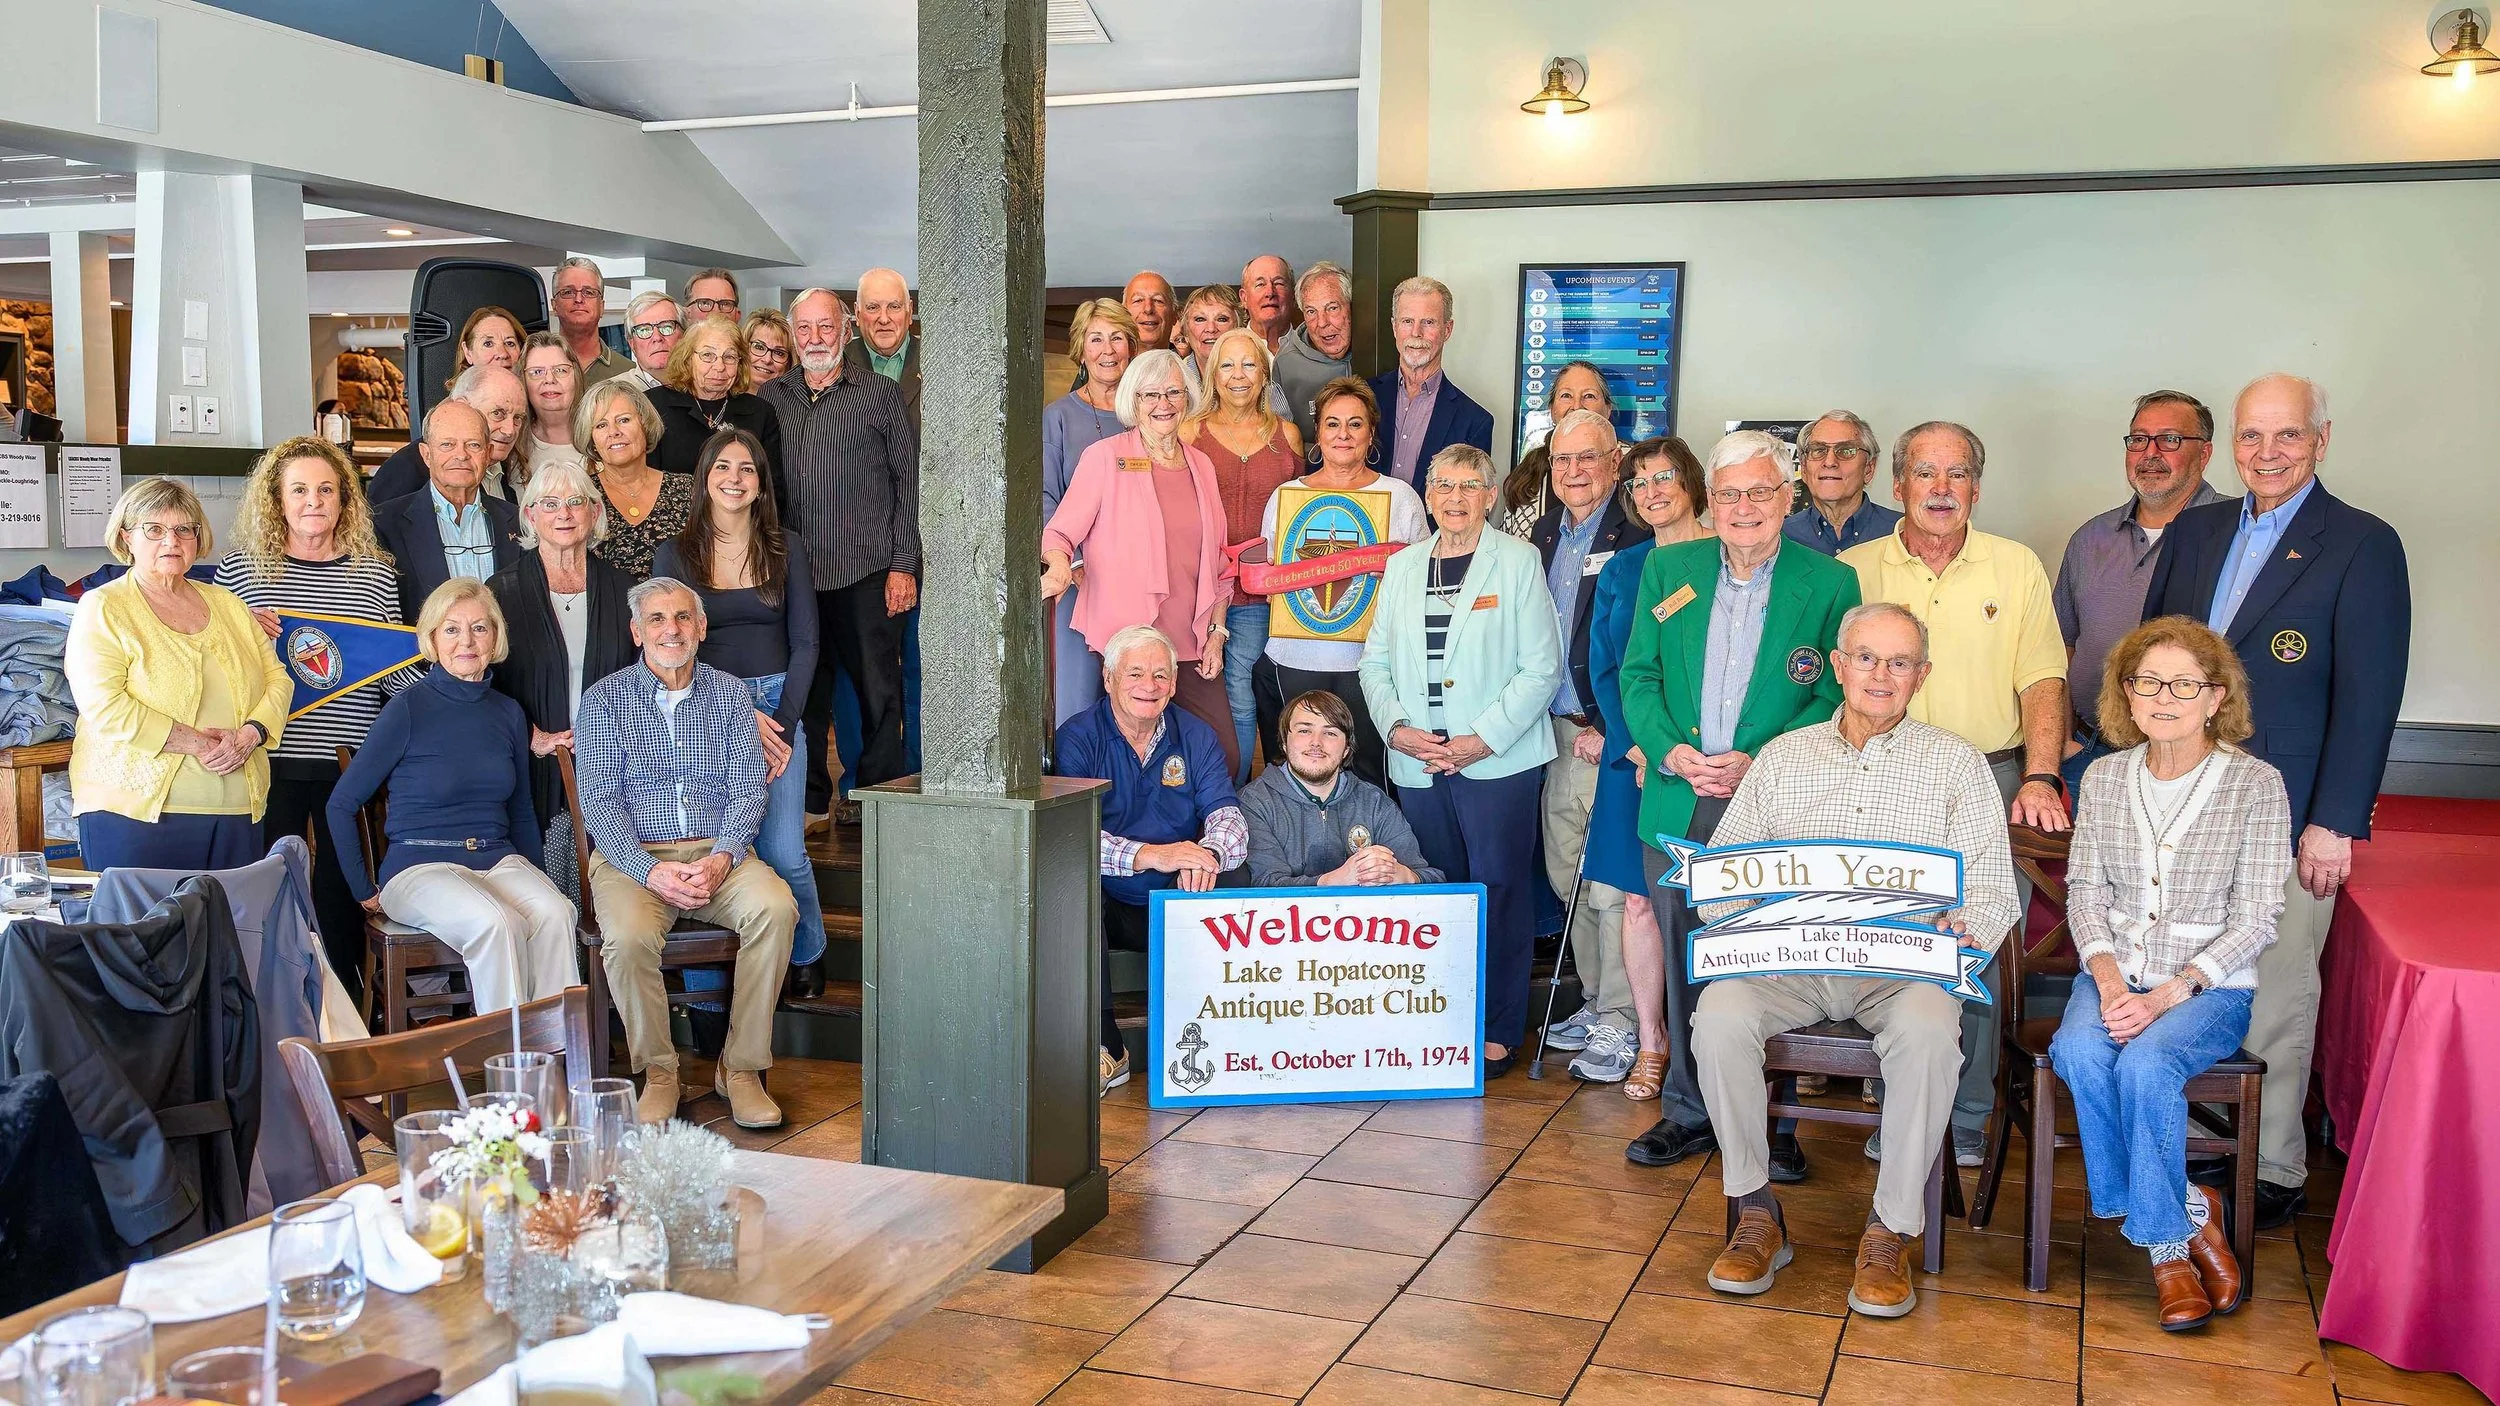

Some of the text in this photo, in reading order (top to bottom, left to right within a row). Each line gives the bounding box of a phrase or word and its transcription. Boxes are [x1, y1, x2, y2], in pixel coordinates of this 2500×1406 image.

[1565, 276, 1636, 285] UPCOMING EVENTS
[0, 513, 41, 522] 3-219-9016
[1264, 562, 1336, 588] Celebrating
[1338, 559, 1352, 572] 50
[1720, 853, 1926, 892] 50 th Year
[1200, 904, 1441, 952] Welcome
[1801, 927, 1935, 952] Lake Hopatcong
[1701, 946, 1869, 970] Antique Boat Club
[1222, 959, 1426, 987] Lake Hopatcong
[1196, 989, 1448, 1024] Antique Boat Club
[1224, 1046, 1470, 1072] Est. October 17th, 1974
